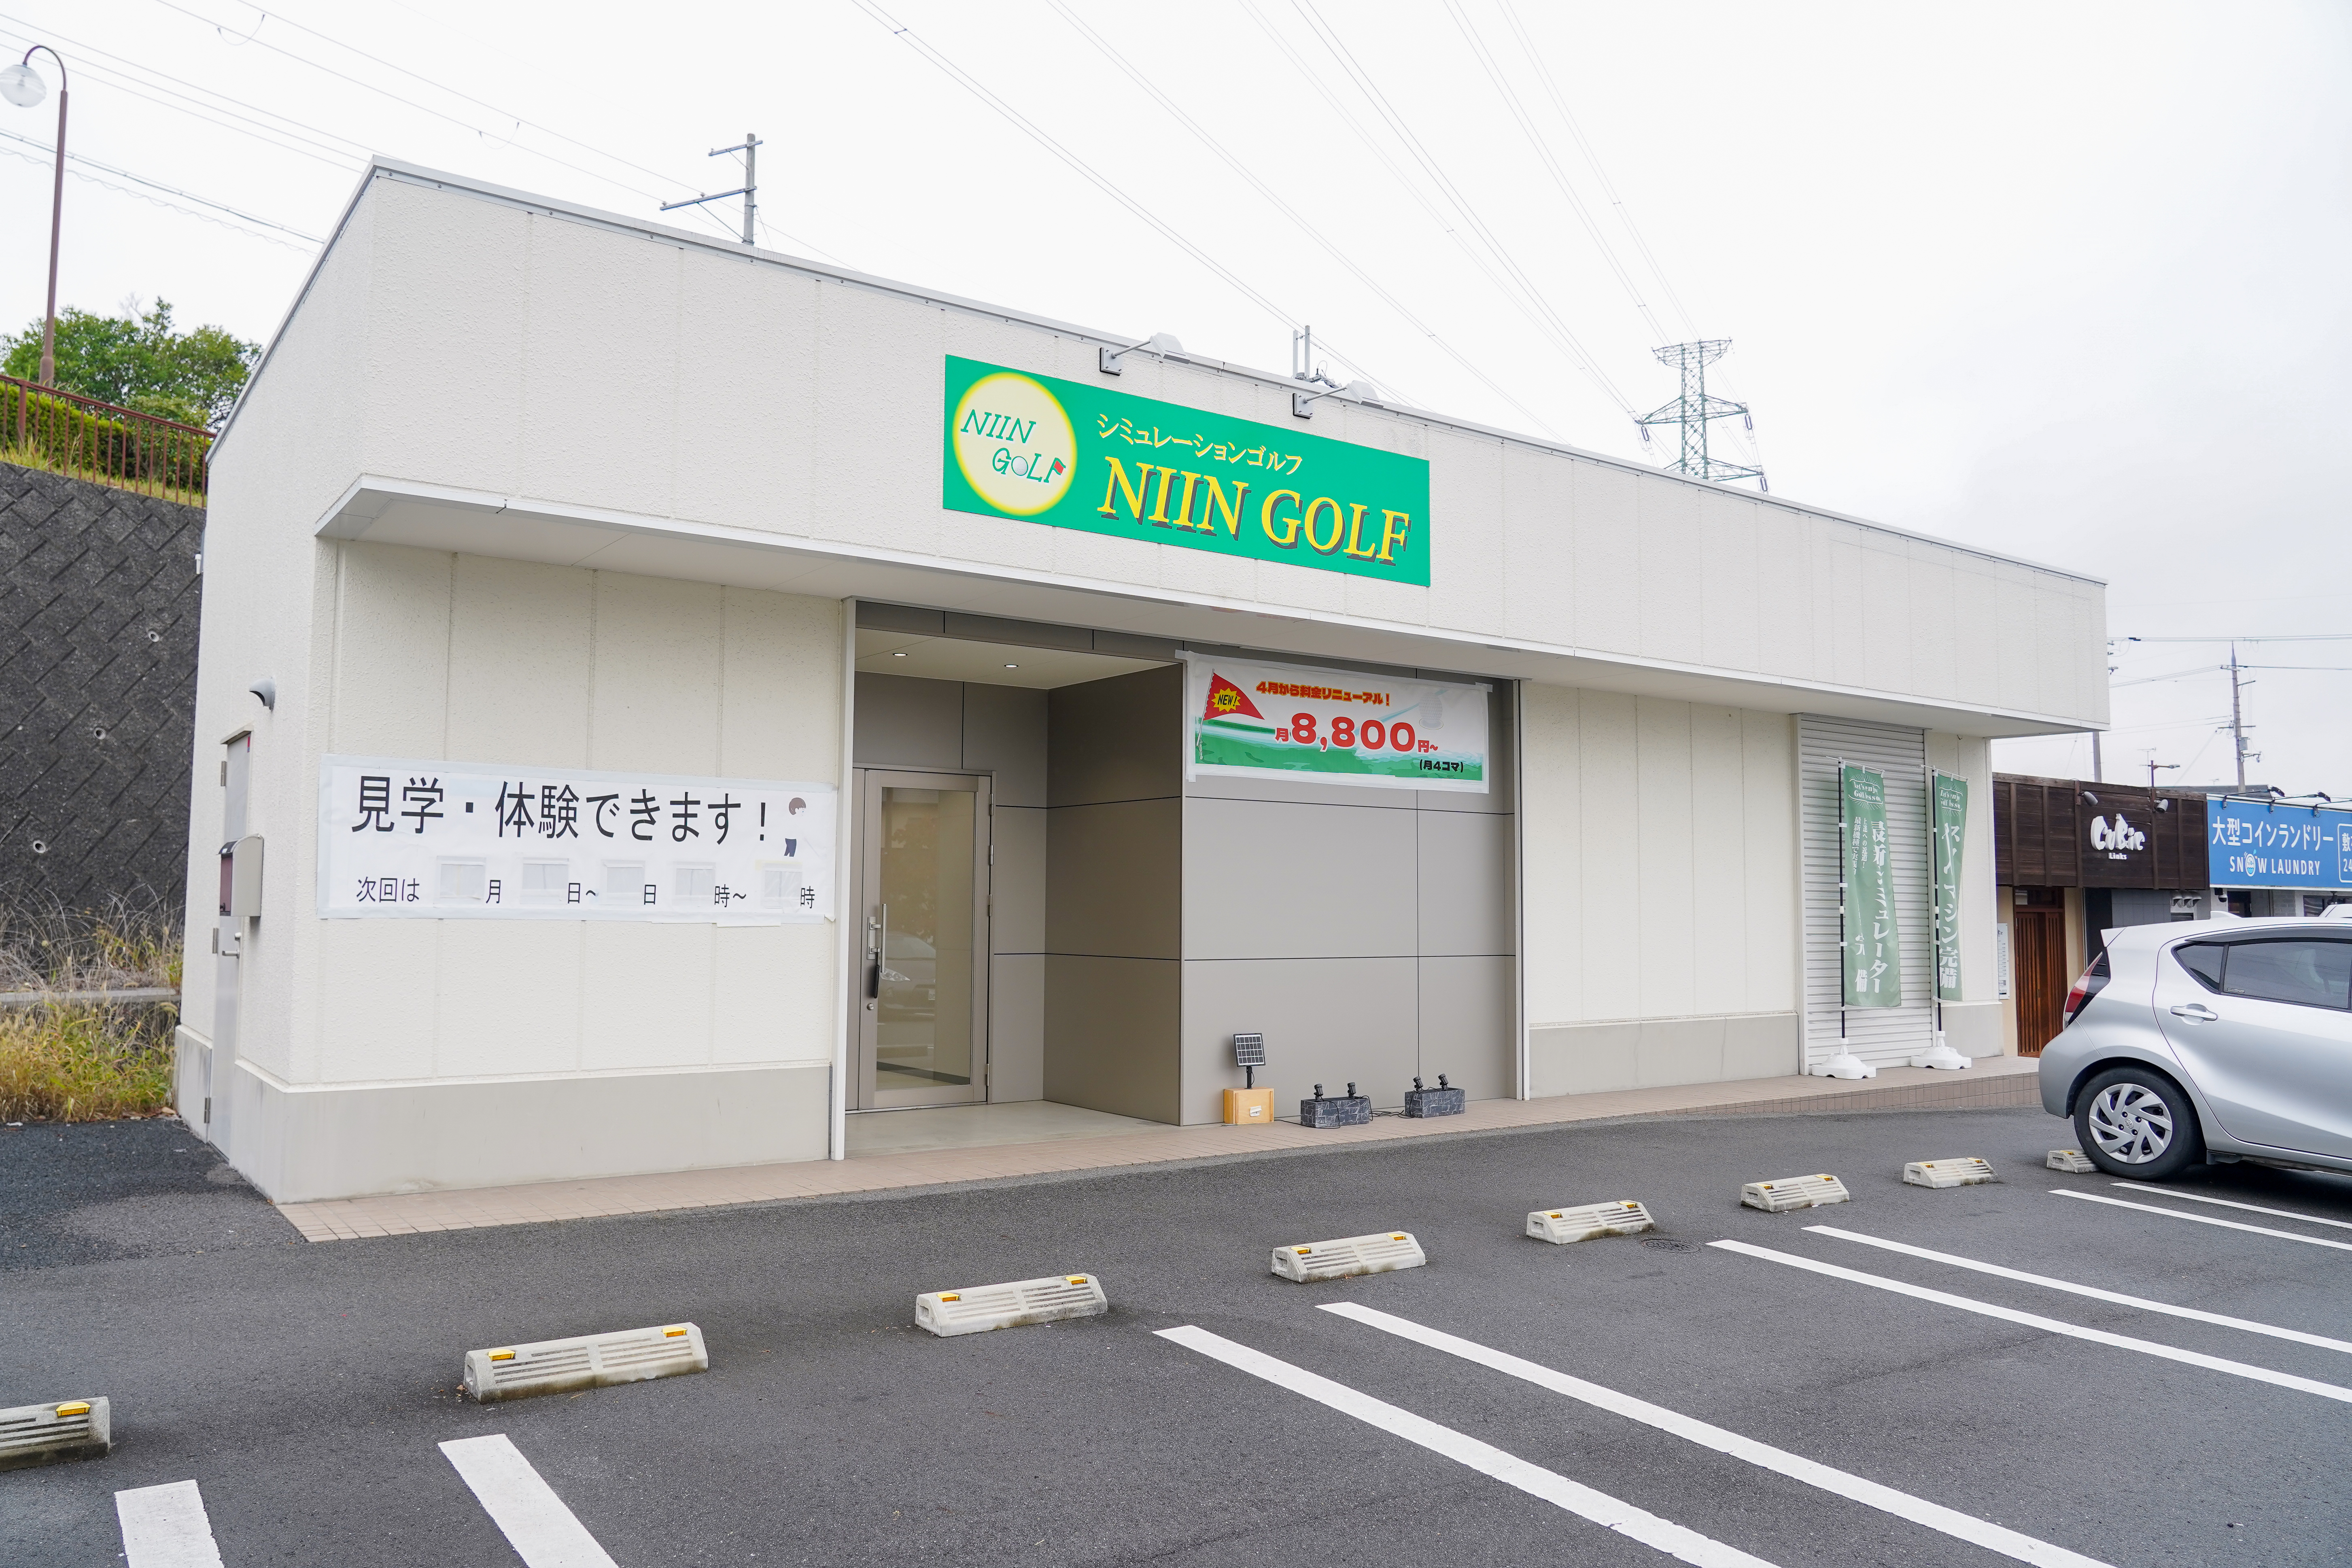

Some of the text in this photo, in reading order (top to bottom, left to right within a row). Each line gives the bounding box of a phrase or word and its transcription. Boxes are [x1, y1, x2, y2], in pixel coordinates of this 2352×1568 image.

[961, 409, 1036, 443] NIIN
[1097, 413, 1303, 475] シミュレーションゴルフ
[992, 448, 1066, 483] GOLF
[1097, 456, 1412, 566] NIIN GOLF
[1217, 694, 1237, 707] NEW!
[1256, 681, 1390, 707] 4月から料金リニューアル！
[1419, 759, 1464, 774] (月4コマ)
[352, 776, 766, 845] 見学・体験できます！
[2212, 816, 2334, 851] 大型コインランドリー
[2342, 832, 2352, 852] 敷
[2108, 852, 2128, 860] Links
[2271, 858, 2320, 876] LAUNDRY
[356, 876, 420, 903] 次回は
[486, 880, 501, 904] 月
[644, 885, 656, 905] 日
[800, 886, 815, 909] 時
